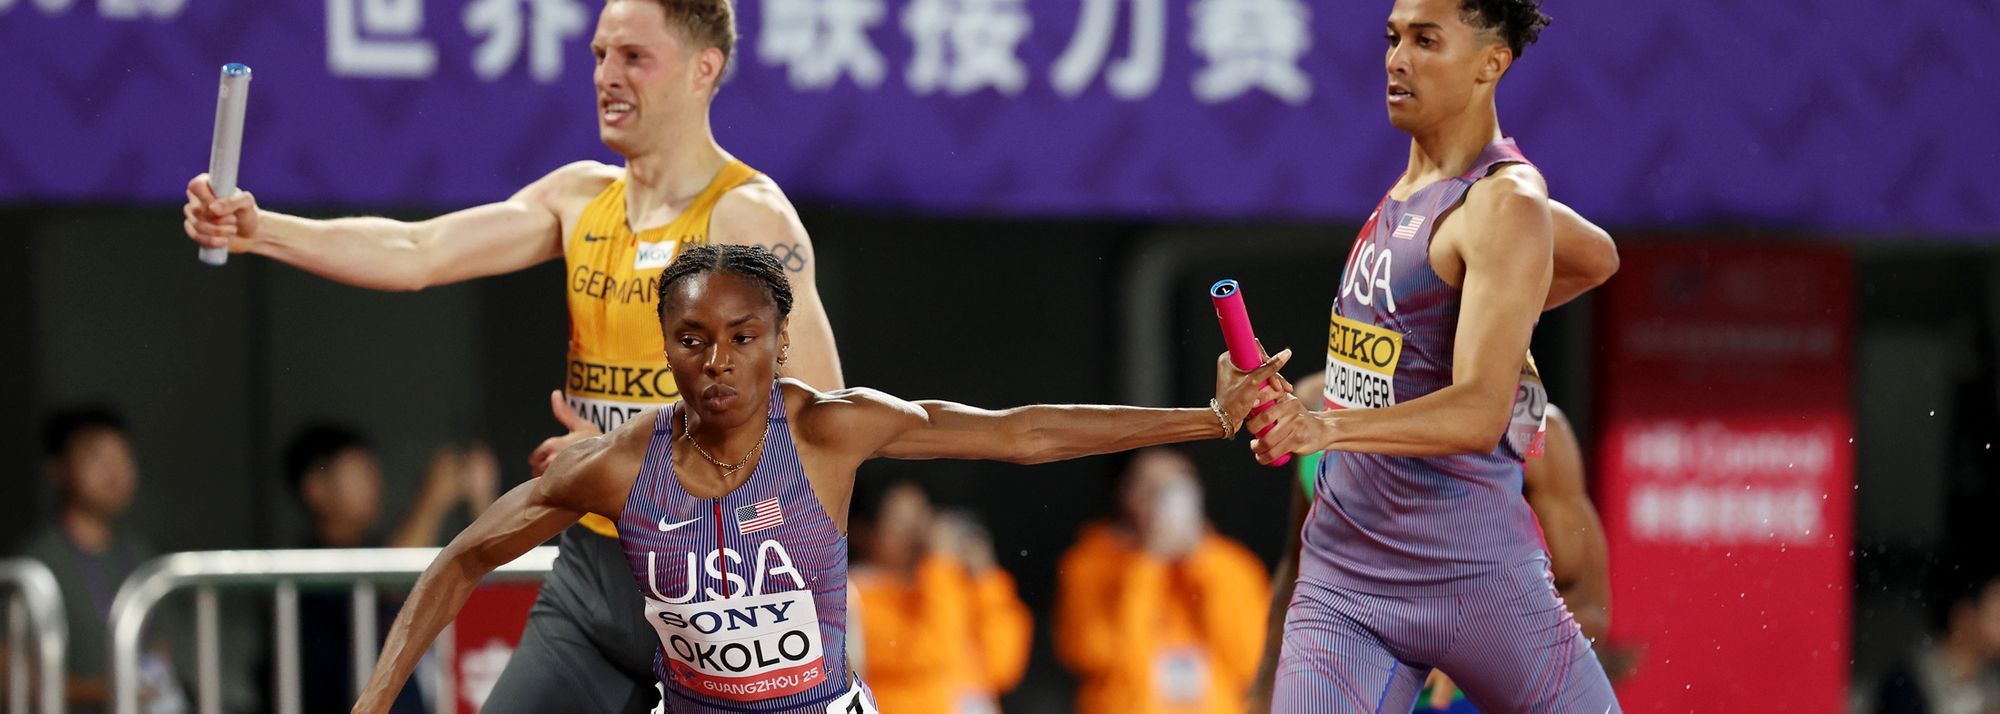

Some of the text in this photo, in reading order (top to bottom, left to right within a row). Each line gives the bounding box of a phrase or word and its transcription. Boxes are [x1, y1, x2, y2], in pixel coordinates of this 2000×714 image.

[573, 265, 661, 304] GERMAN
[1342, 238, 1396, 313] USA
[1330, 321, 1395, 368] EIKO
[570, 360, 681, 398] SEIKO
[1327, 361, 1390, 409] CKBURGER
[648, 539, 806, 604] USA
[659, 600, 795, 635] SONY
[670, 629, 810, 673] OKOLO
[703, 666, 819, 695] GUANGZHOU 25
